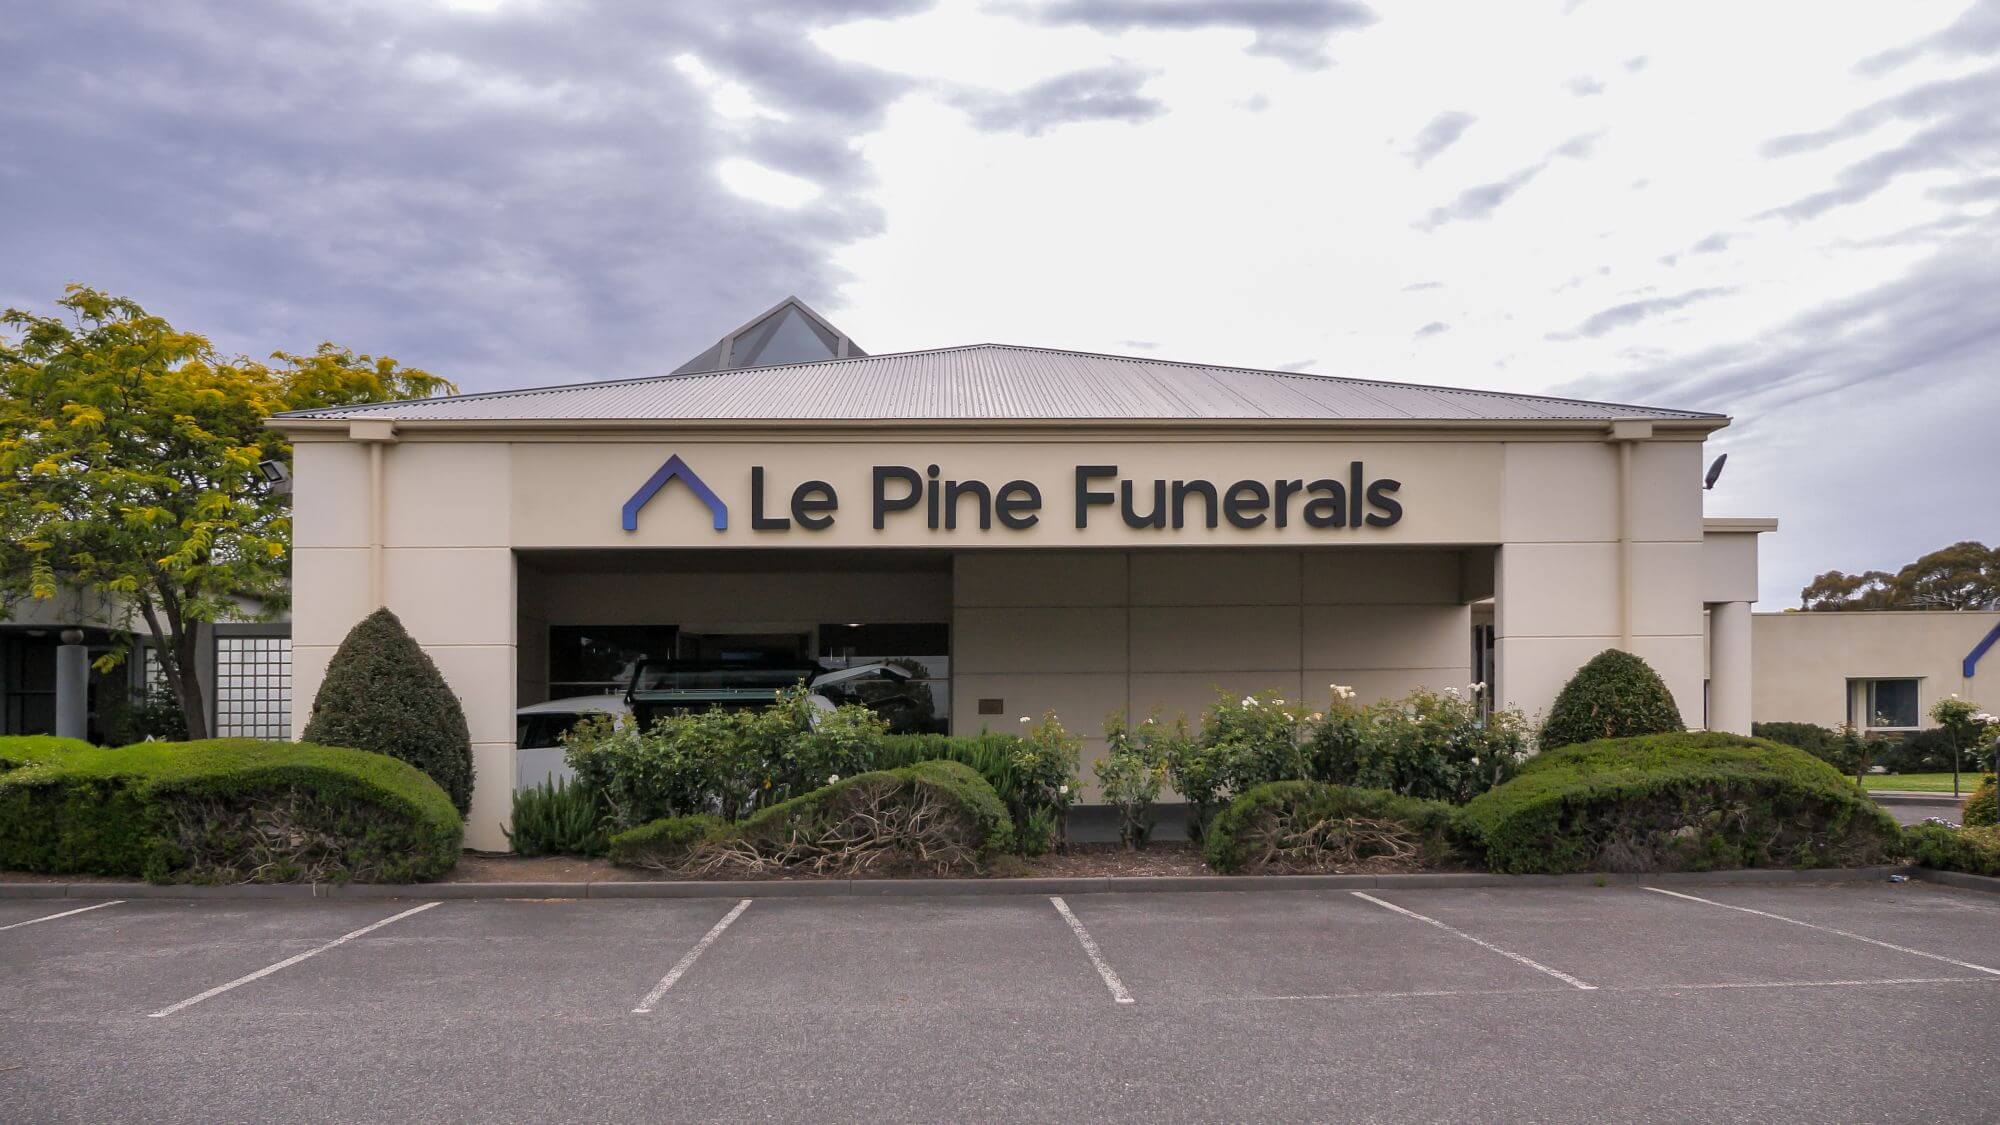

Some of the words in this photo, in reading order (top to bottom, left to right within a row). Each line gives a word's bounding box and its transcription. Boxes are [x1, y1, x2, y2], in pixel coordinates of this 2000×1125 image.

[751, 466, 839, 531] Le
[872, 463, 1042, 530] Pine
[1075, 461, 1403, 529] Funerals
